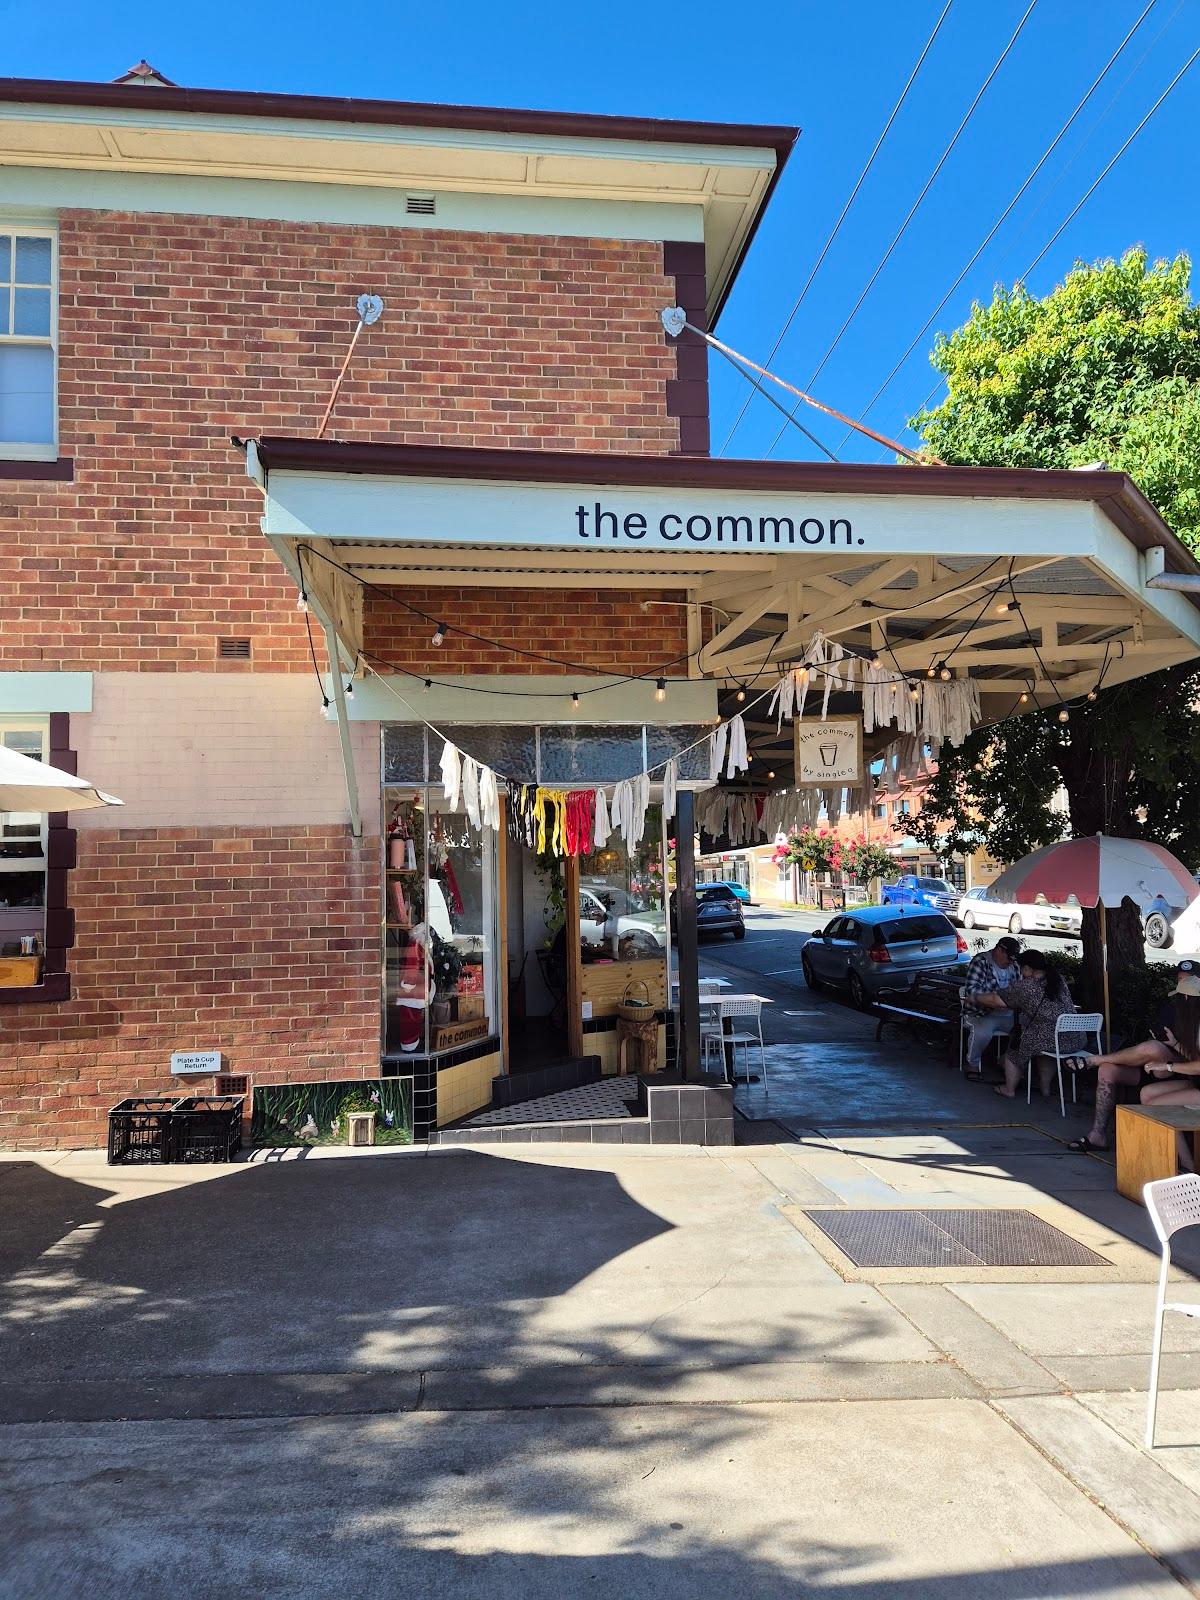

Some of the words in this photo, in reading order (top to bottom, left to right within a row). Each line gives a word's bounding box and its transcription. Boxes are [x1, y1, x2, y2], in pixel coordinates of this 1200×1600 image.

[575, 502, 647, 539] the
[659, 513, 865, 545] common.
[800, 733, 815, 743] the
[817, 728, 854, 740] common
[803, 765, 814, 776] by
[816, 769, 847, 778] single
[440, 1033, 453, 1047] the
